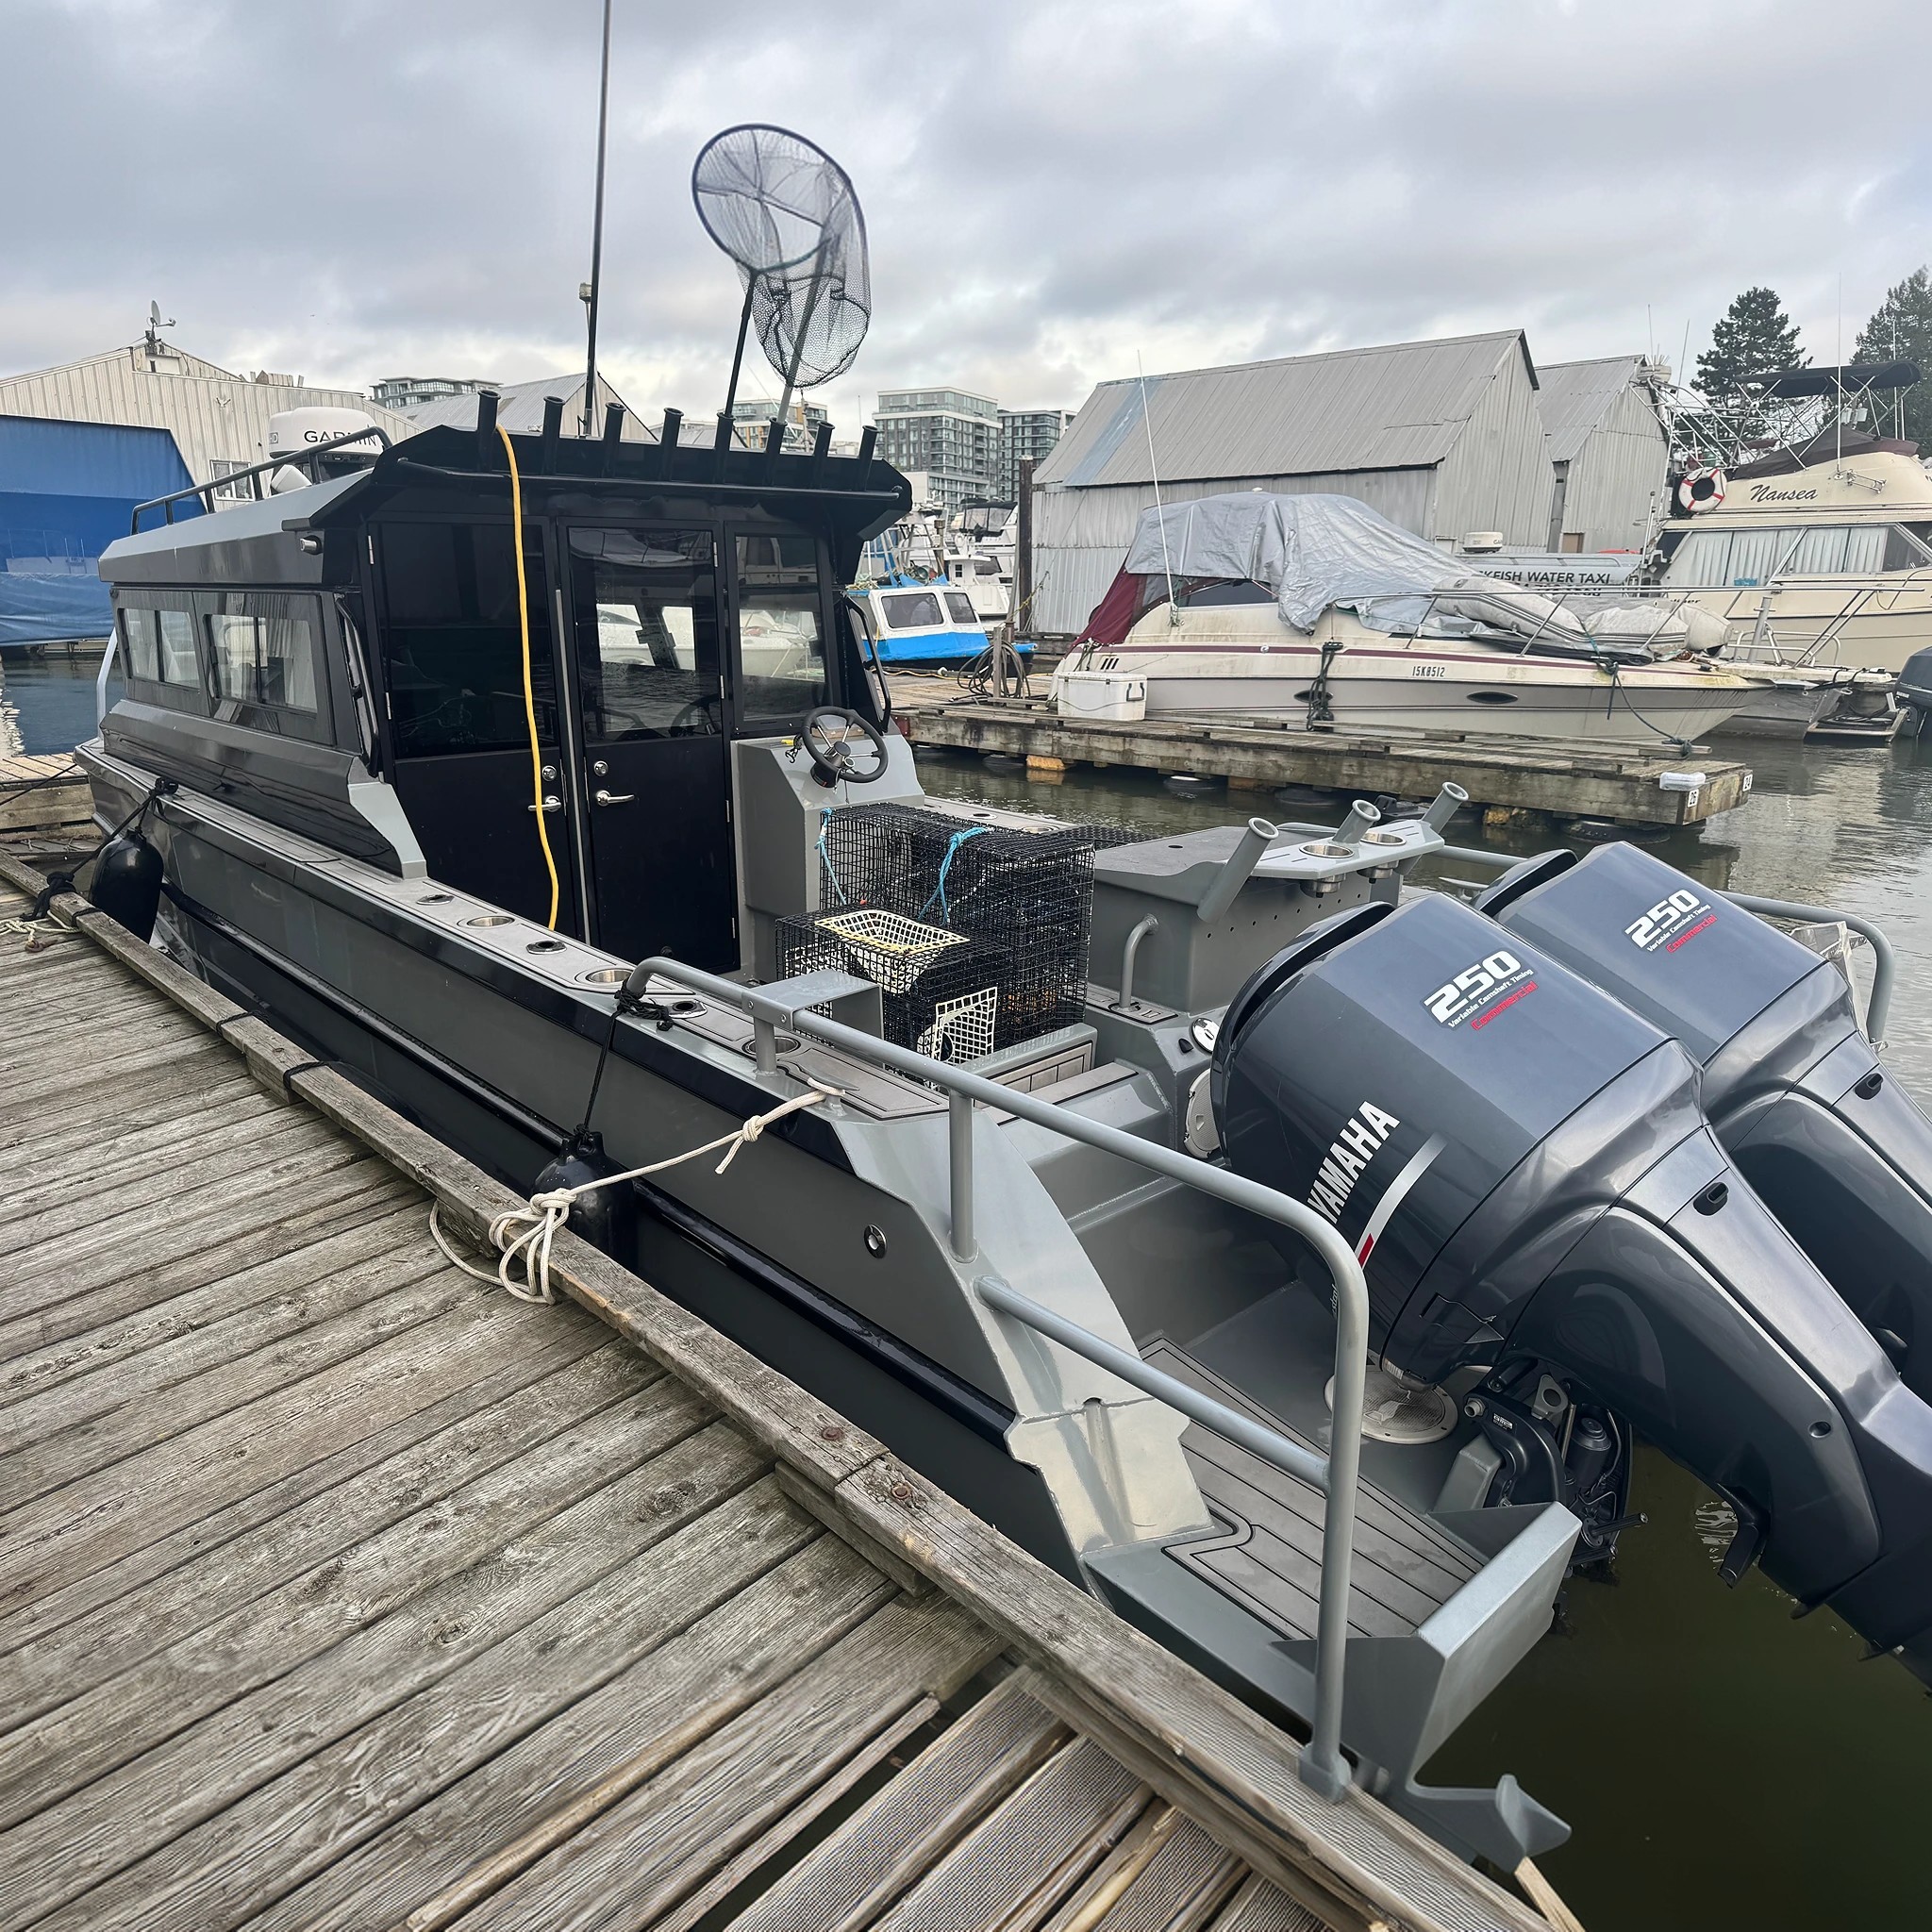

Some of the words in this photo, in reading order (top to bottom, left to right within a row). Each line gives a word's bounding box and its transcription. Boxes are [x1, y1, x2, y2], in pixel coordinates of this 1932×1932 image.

[304, 430, 377, 446] GARIN
[1750, 484, 1819, 503] Nansea
[1479, 570, 1523, 581] KFISH
[1527, 571, 1574, 583] WATER
[1578, 573, 1610, 584] TAXI
[1689, 791, 1698, 806] 26
[1624, 890, 1700, 948] 250
[1666, 914, 1718, 954] Commercial
[1647, 932, 1671, 952] Variable
[1424, 951, 1521, 1024] 250
[1448, 1003, 1479, 1027] Variable
[1478, 981, 1512, 1005] Camshaft
[1510, 969, 1534, 984] Timing
[1471, 980, 1539, 1030] Commercial
[1307, 1100, 1400, 1224] YAMAHA
